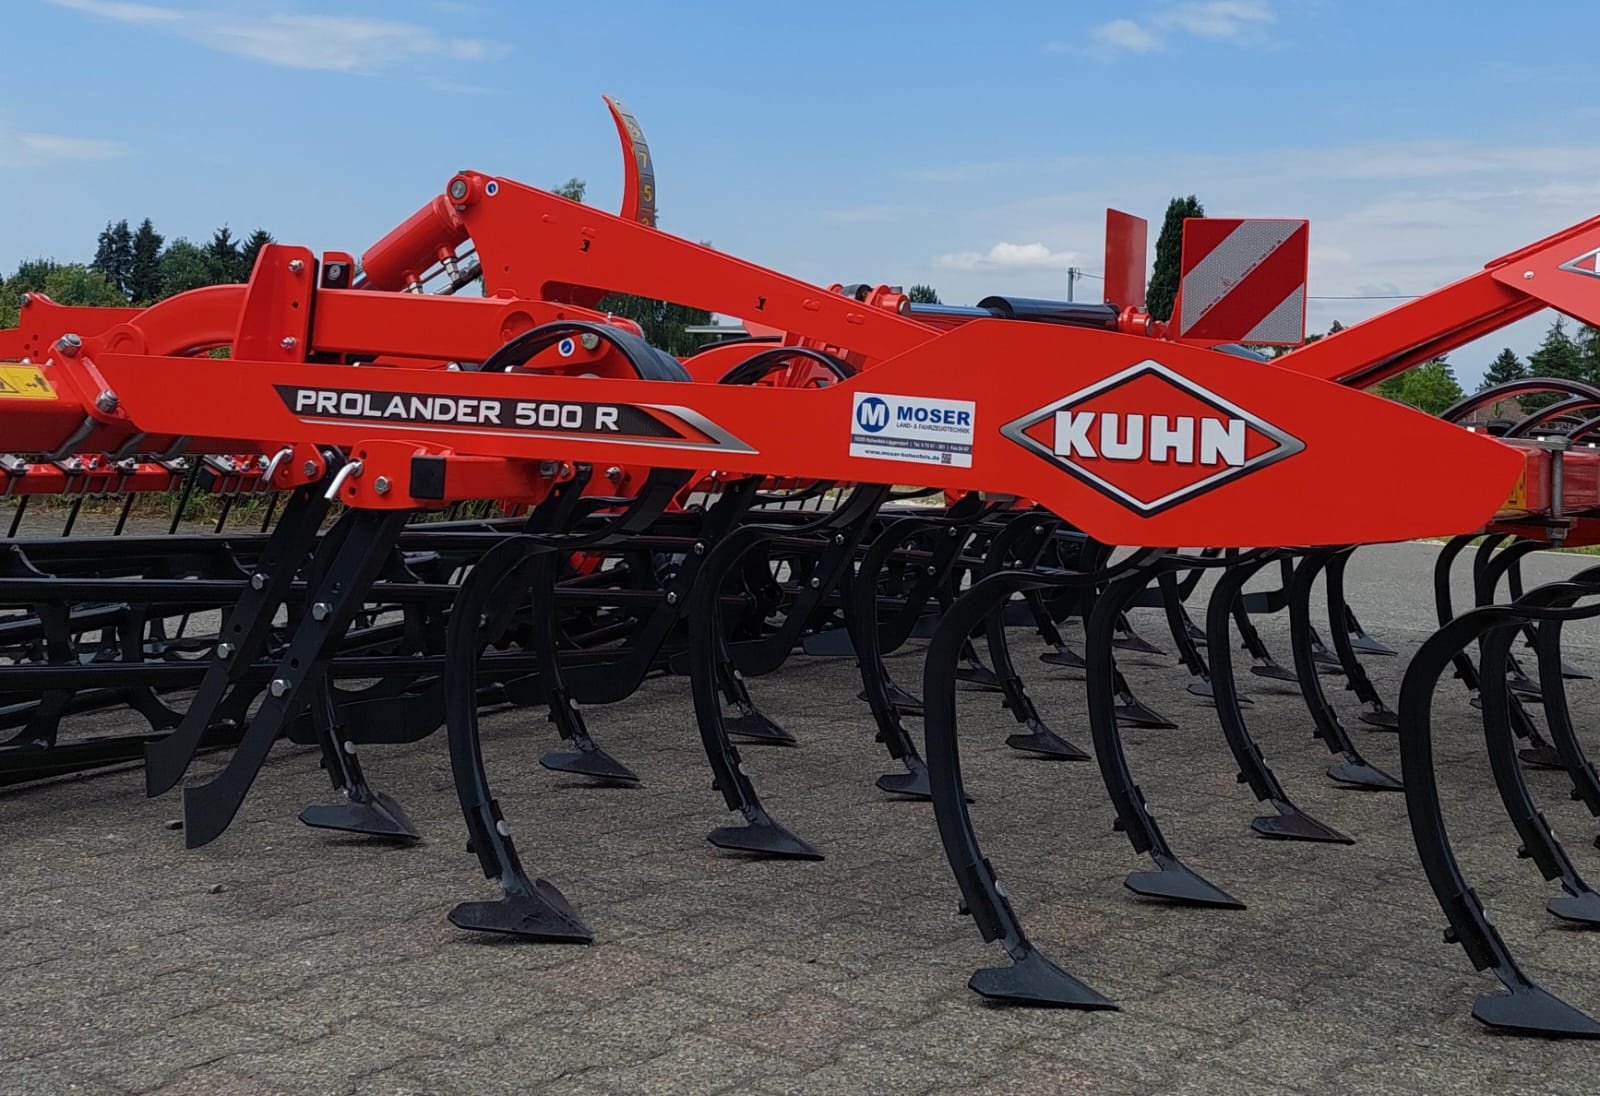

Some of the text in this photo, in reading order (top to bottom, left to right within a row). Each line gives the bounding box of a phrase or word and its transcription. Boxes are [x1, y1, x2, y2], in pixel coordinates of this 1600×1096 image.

[638, 151, 647, 169] 7
[644, 184, 652, 202] 5
[295, 390, 620, 432] PROLANDER 500 R
[861, 402, 885, 426] M
[897, 406, 971, 426] MOSER
[918, 424, 970, 434] FAHRZEUGTECHNIK
[1053, 410, 1246, 467] KUHN
